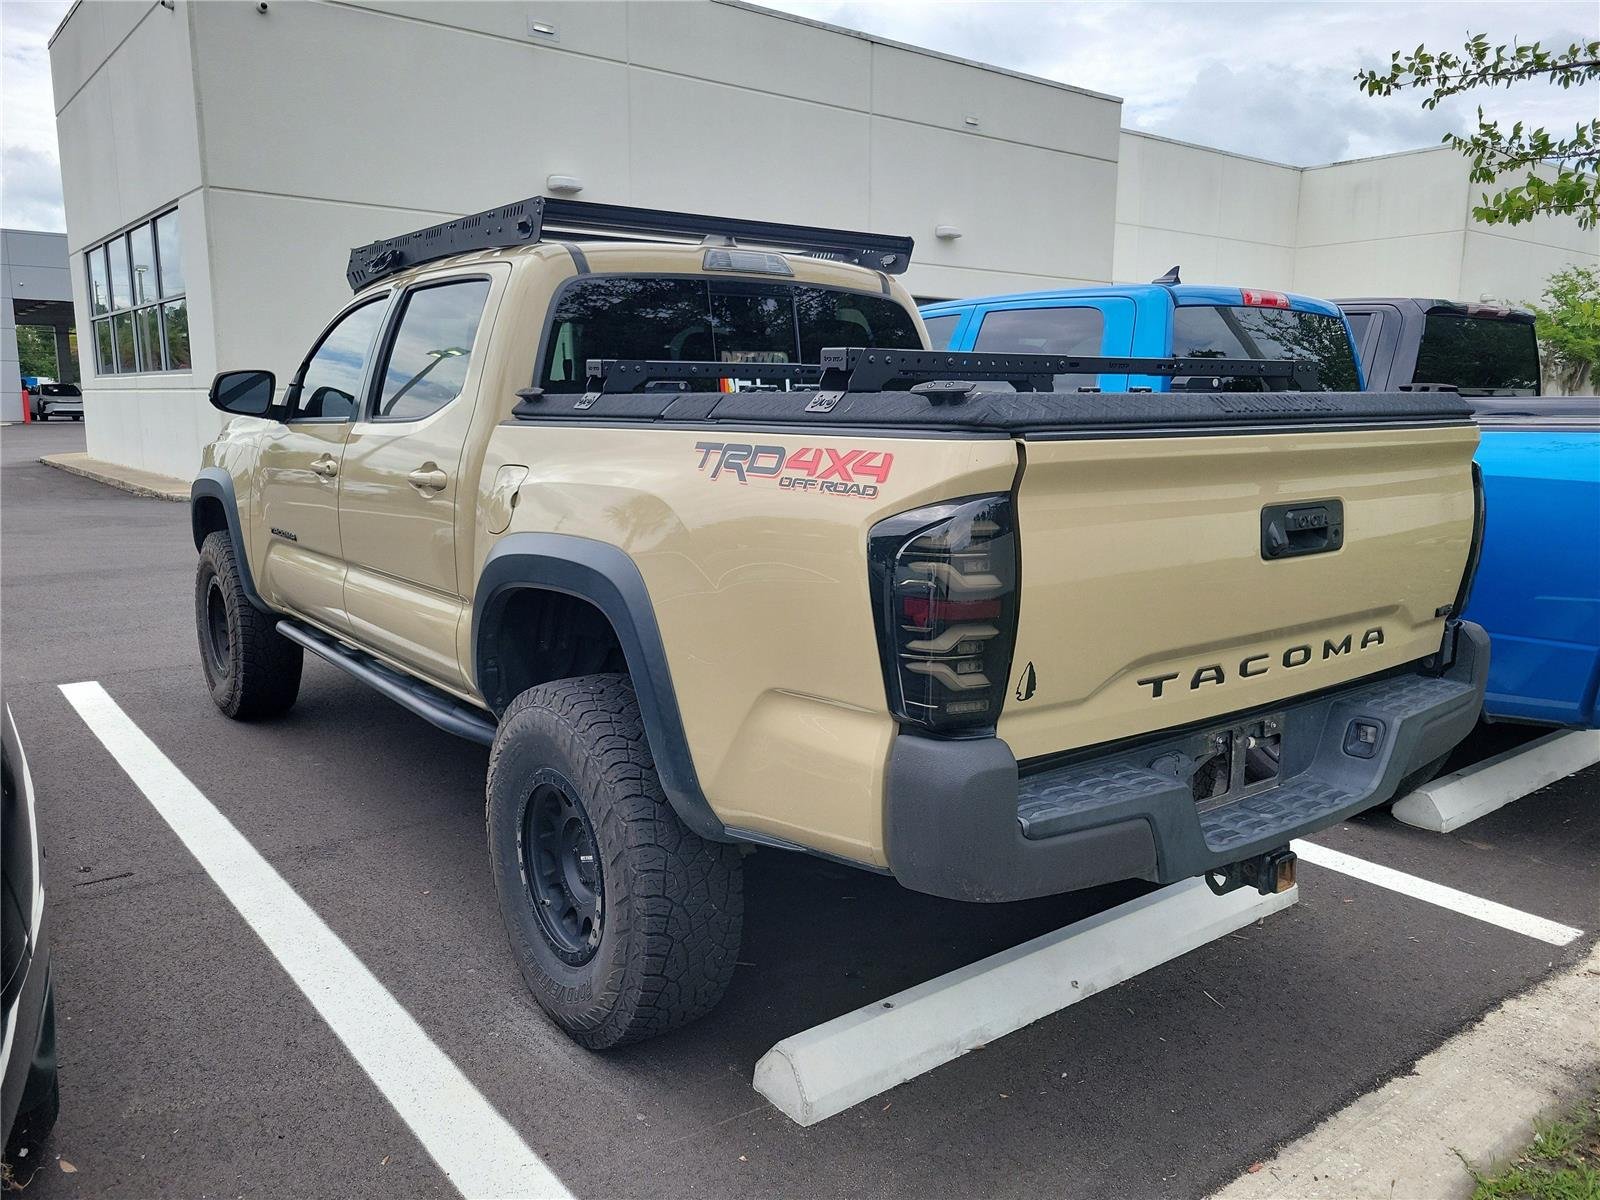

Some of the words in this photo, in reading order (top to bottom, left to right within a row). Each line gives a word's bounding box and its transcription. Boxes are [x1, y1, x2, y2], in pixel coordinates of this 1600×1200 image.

[694, 441, 787, 486] TRD
[785, 446, 894, 485] 4X4
[778, 476, 819, 492] OFF
[819, 480, 880, 500] ROAD
[1293, 511, 1329, 529] TOYOTA
[1136, 626, 1385, 699] TACOMA
